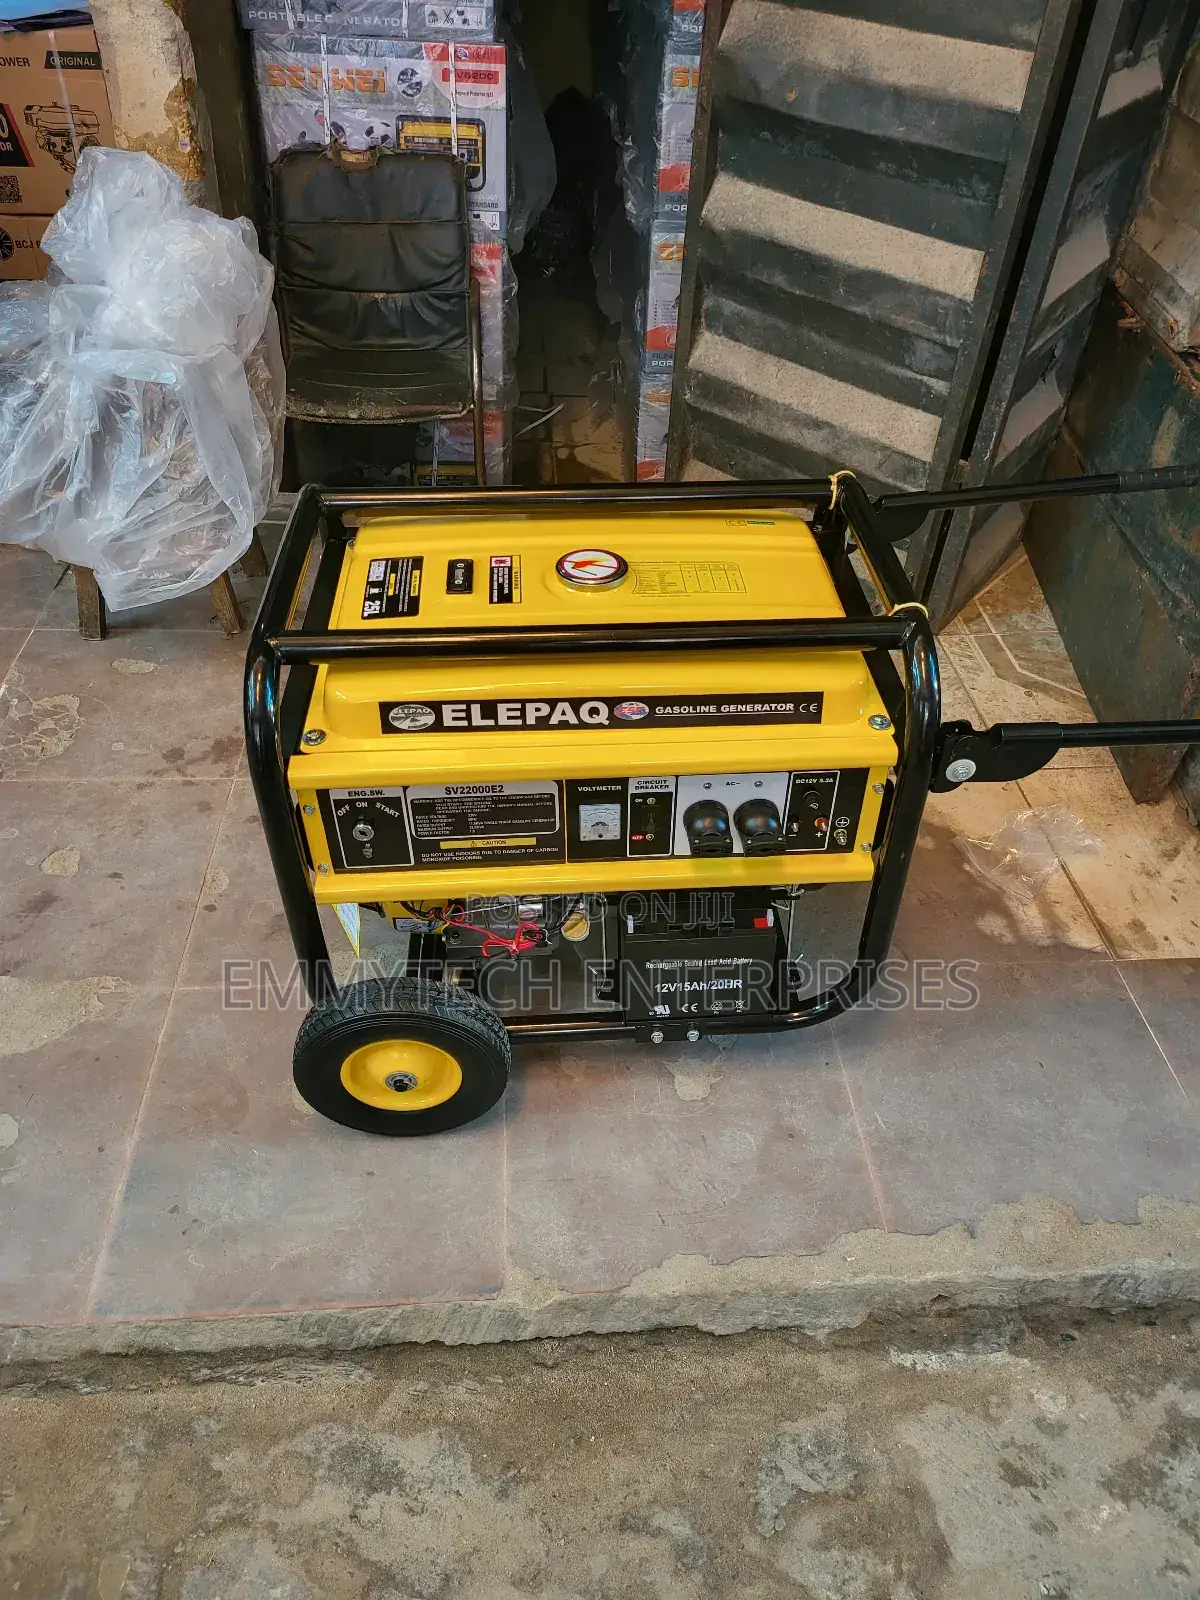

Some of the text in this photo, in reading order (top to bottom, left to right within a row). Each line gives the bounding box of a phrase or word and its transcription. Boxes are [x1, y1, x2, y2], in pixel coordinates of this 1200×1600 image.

[50, 56, 96, 66] ORIGINAL
[15, 240, 34, 249] BCJ
[441, 700, 610, 727] ELEPAQ
[655, 704, 718, 715] GASOLINE
[720, 702, 795, 714] GENERATOR
[347, 789, 386, 798] ENG.SW.
[444, 784, 504, 796] SV22000E2
[337, 804, 351, 817] OFF
[375, 801, 401, 818] START
[645, 956, 753, 970] Rechargeable Sealed Lead Acid Battery
[654, 979, 743, 993] 12V15Ah/20HR
